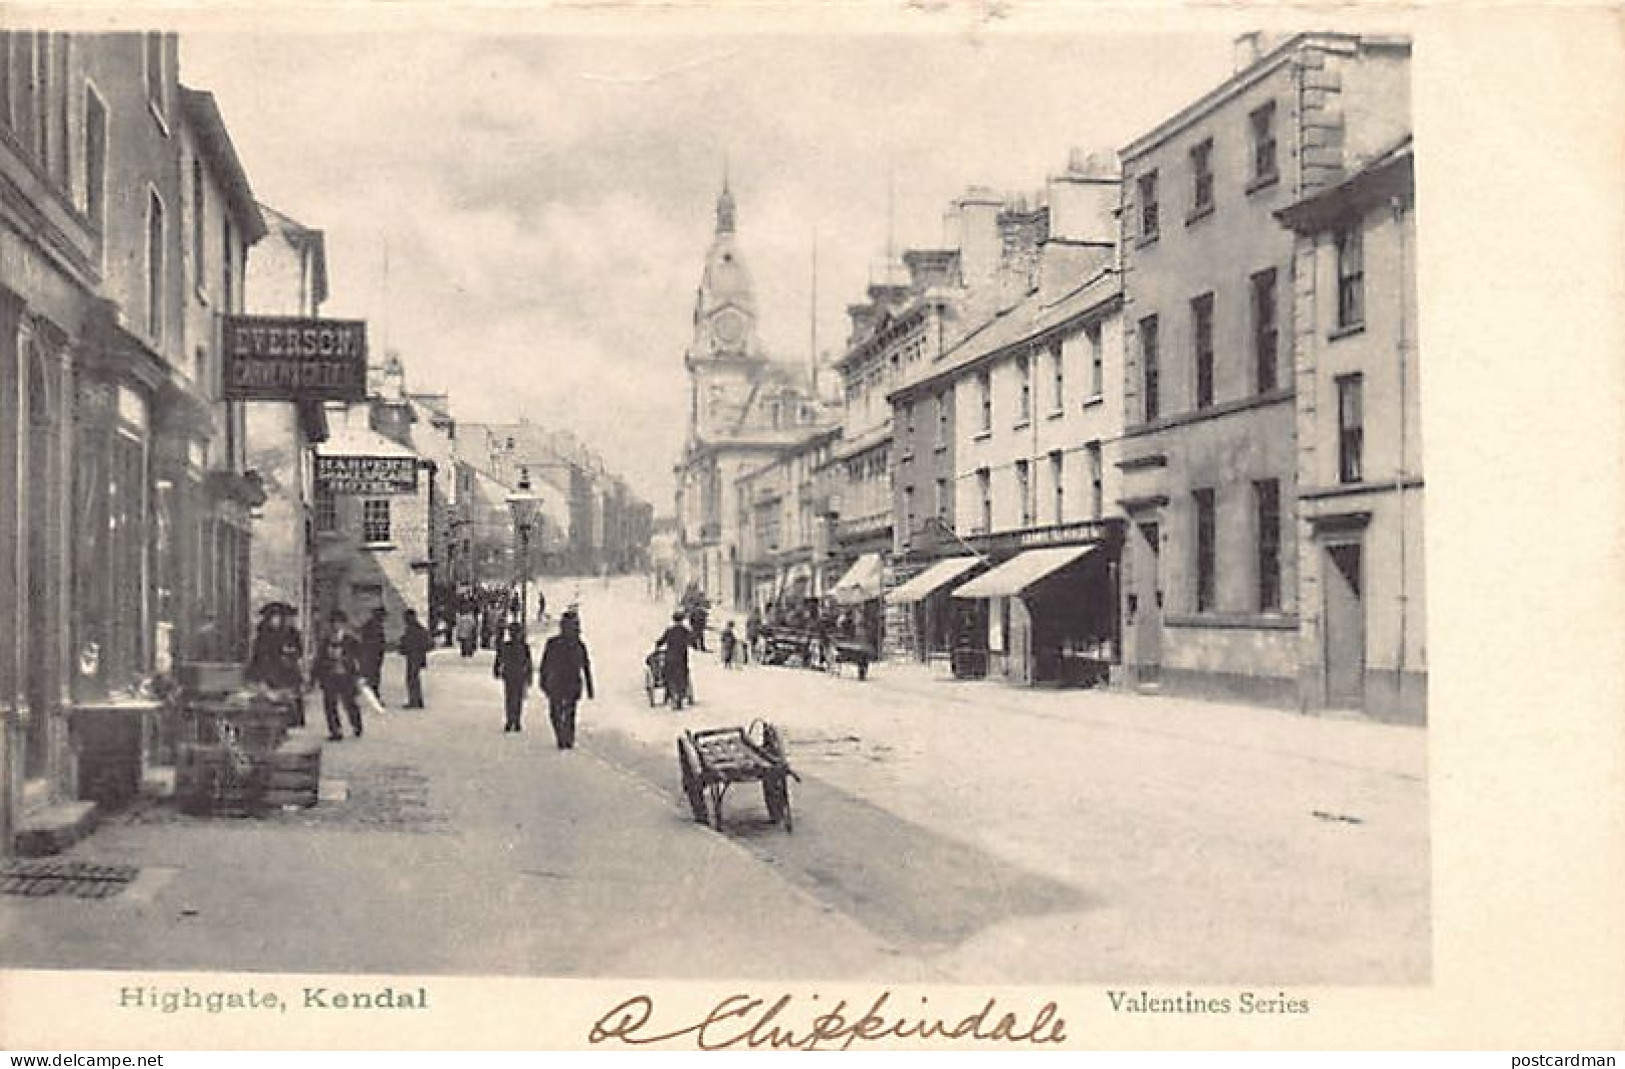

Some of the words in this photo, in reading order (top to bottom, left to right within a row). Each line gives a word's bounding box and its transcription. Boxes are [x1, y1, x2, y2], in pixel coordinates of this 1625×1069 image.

[120, 986, 287, 1013] Highgate,
[303, 987, 428, 1009] Kendal
[1106, 990, 1232, 1014] Valentines
[1239, 991, 1310, 1014] Series
